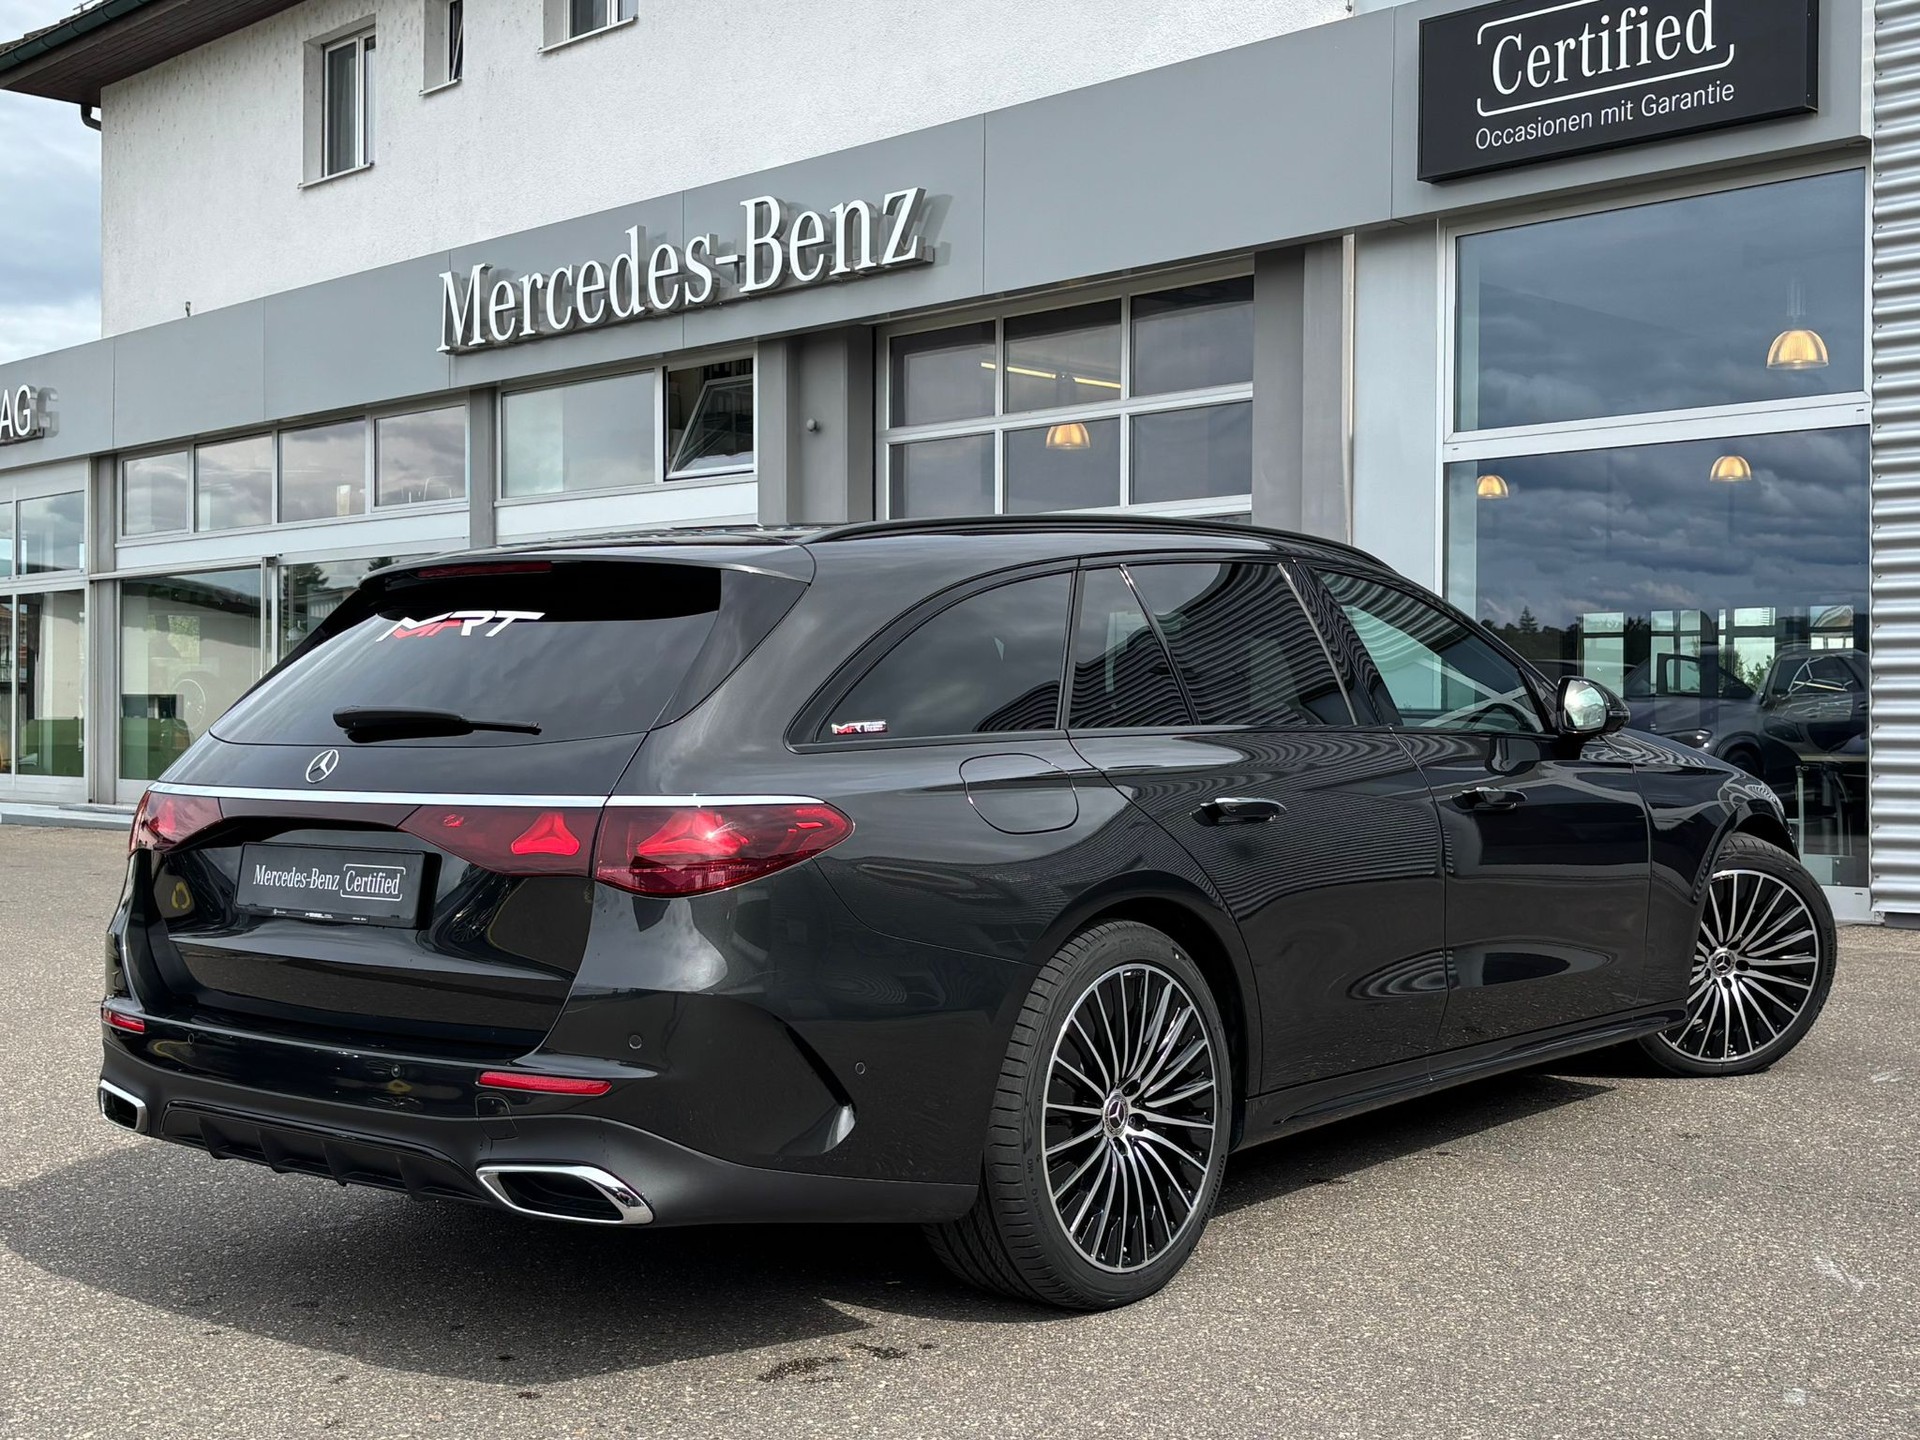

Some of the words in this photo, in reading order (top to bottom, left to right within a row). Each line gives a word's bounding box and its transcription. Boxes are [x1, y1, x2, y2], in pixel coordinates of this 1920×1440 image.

[1491, 0, 1717, 96] Certified
[1475, 113, 1593, 150] Occasionen
[1600, 102, 1634, 126] mit
[1641, 80, 1735, 118] Garantie
[436, 187, 929, 354] Mercedes-Benz
[0, 384, 31, 439] AG
[253, 864, 340, 891] Mercedes-Benz
[345, 870, 400, 895] Certified
